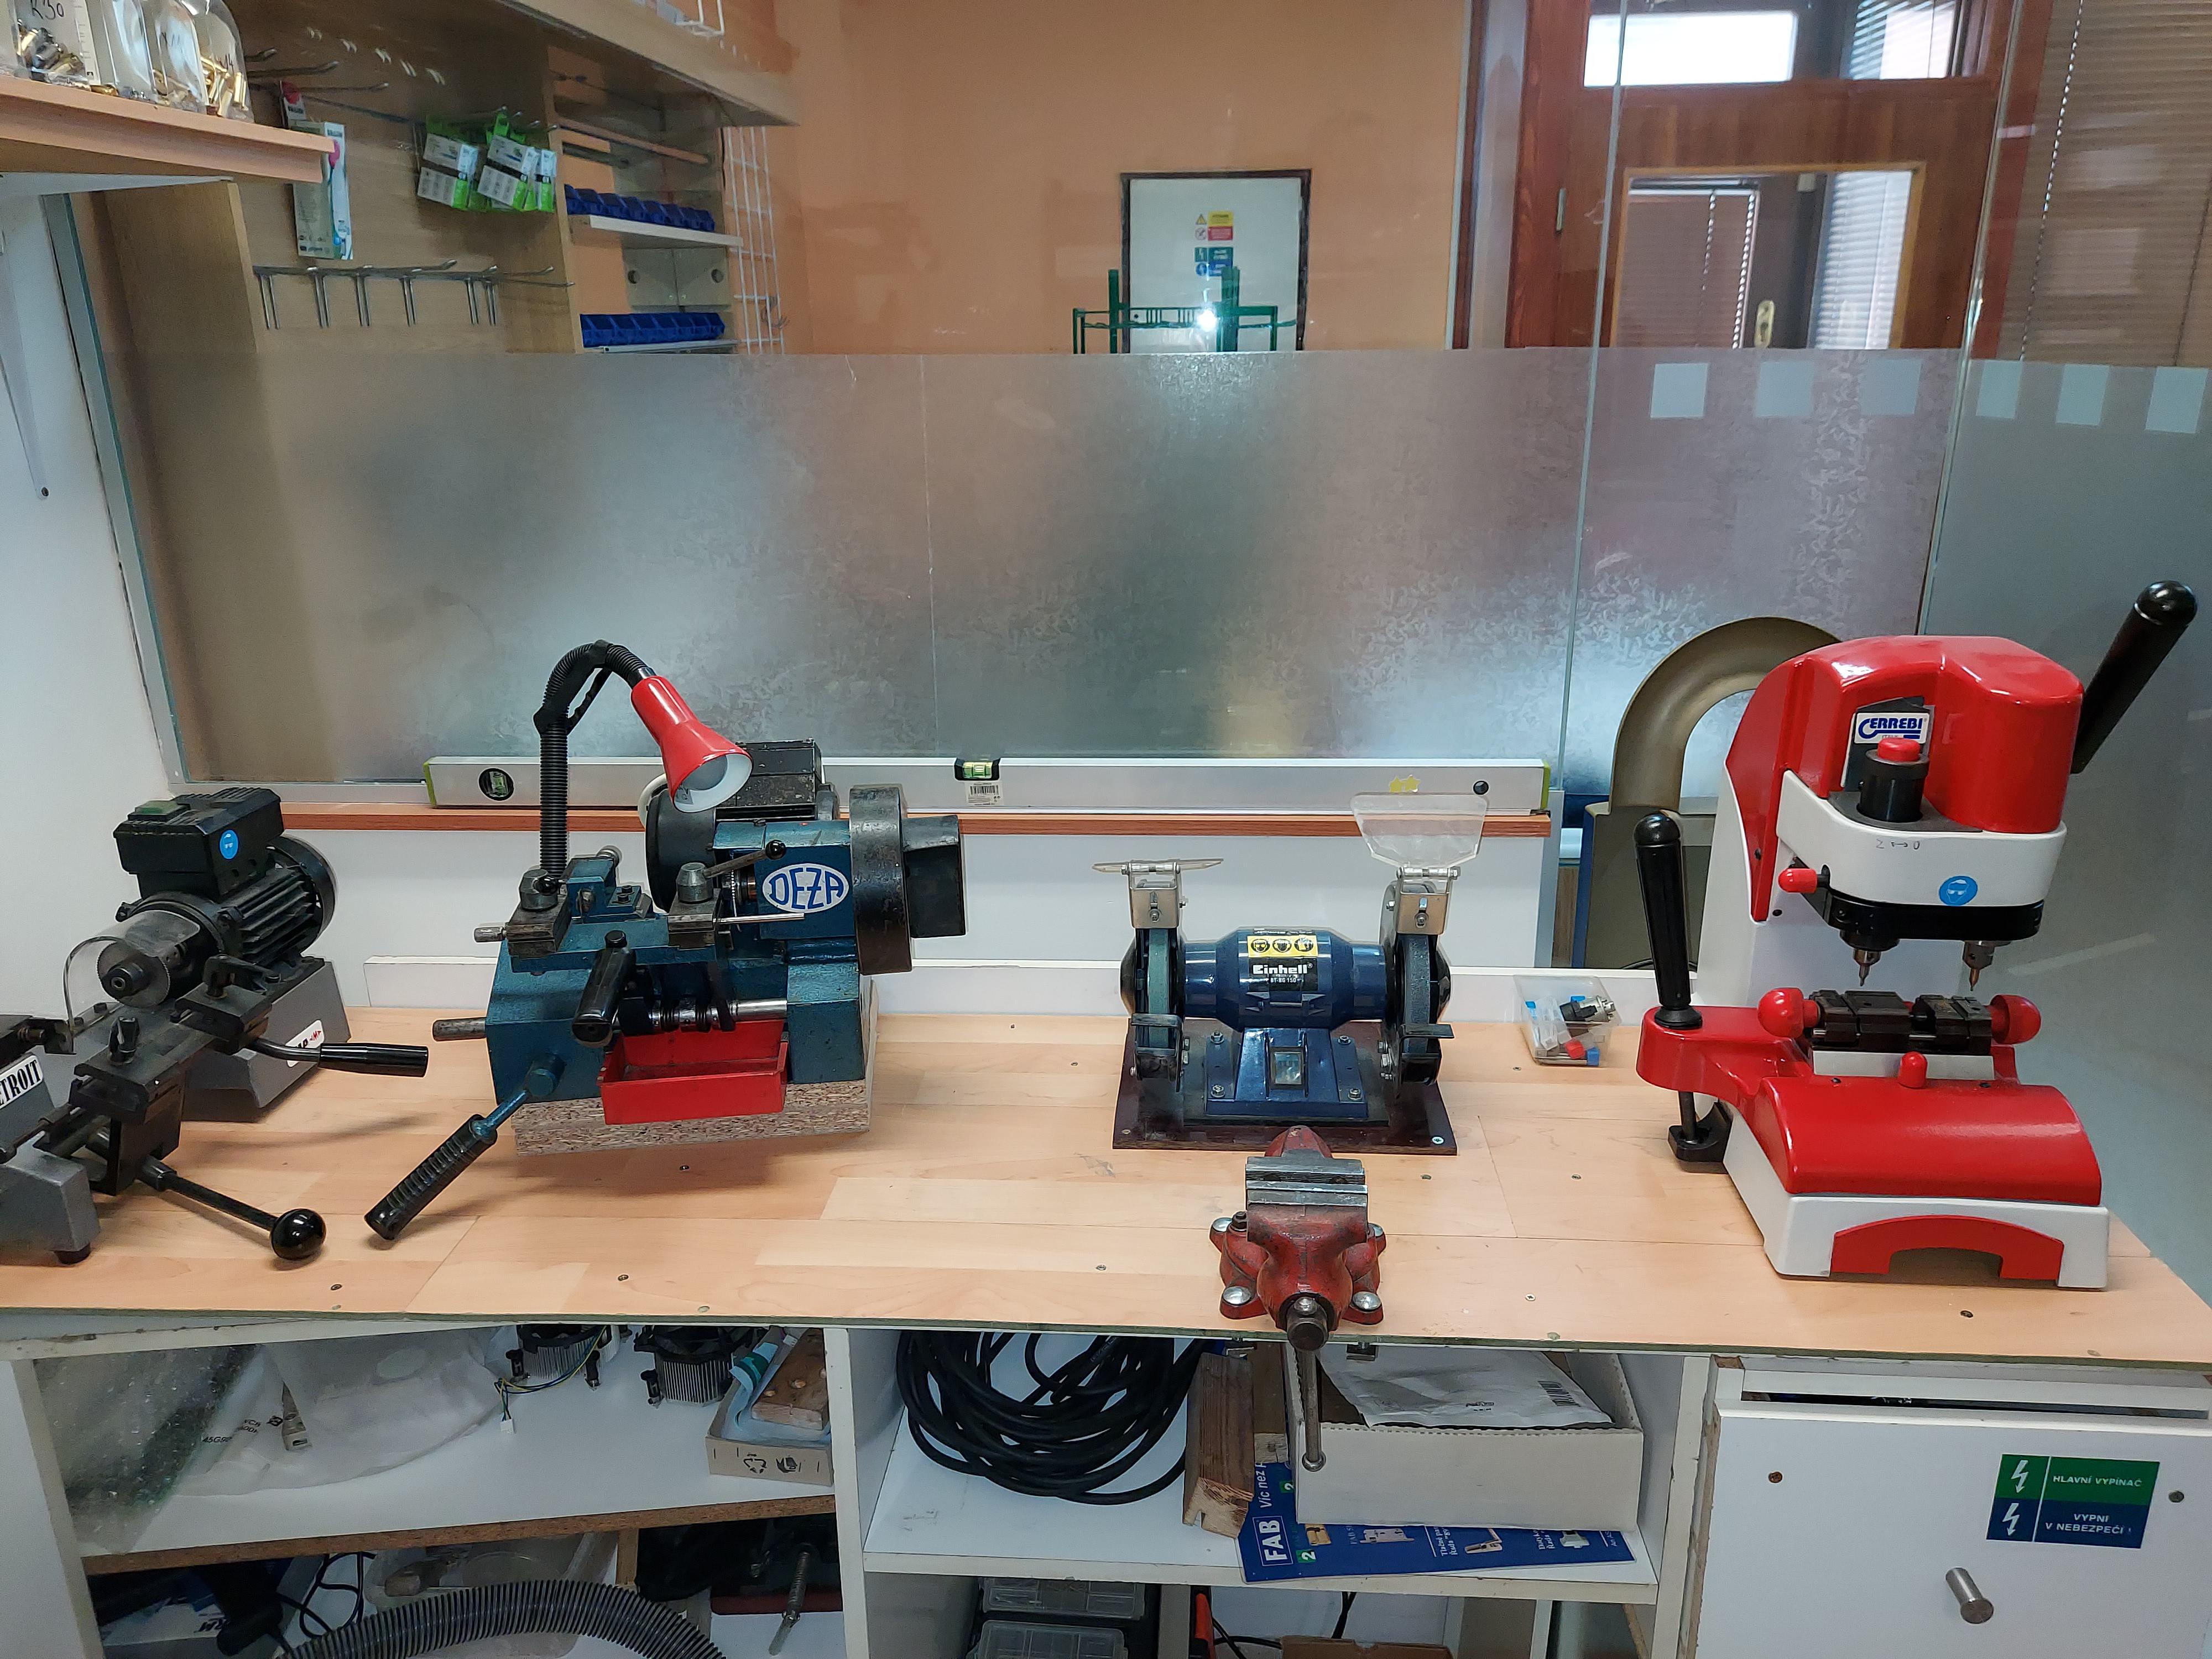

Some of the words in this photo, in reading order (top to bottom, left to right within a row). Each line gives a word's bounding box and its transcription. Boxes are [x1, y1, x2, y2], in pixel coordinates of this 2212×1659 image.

[768, 867, 844, 910] DEZA
[2053, 1475, 2093, 1484] HLAVNÍ
[1284, 1483, 1294, 1491] 2
[1257, 1491, 1272, 1509] Víc
[2046, 1522, 2053, 1530] V
[1259, 1520, 1288, 1561] FAB
[1301, 1551, 1317, 1561] 2
